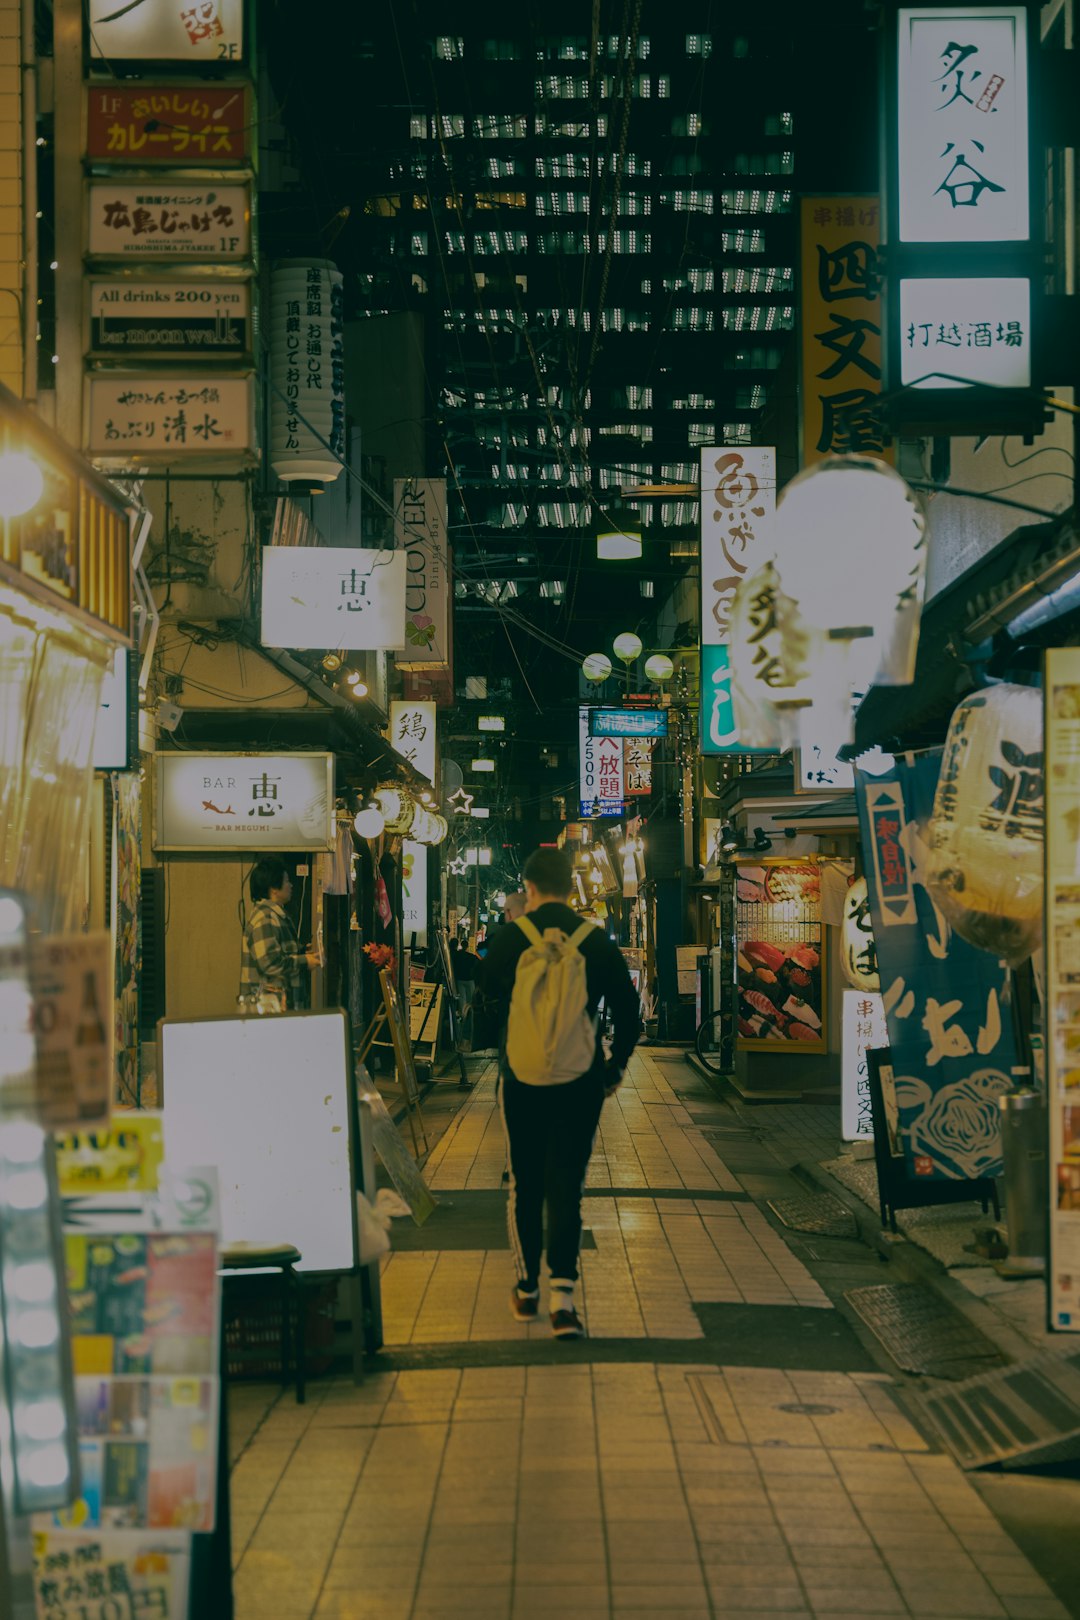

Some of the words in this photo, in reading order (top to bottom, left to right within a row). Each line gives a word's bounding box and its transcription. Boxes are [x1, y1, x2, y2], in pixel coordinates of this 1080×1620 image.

[217, 43, 238, 59] 2F
[99, 93, 122, 114] 1F
[132, 94, 209, 119] おいしい
[106, 122, 233, 153] カレーライス
[931, 41, 1007, 208] 炙谷
[123, 244, 178, 252] HIROSHIMA
[220, 237, 239, 252] 1F
[99, 290, 119, 303] All
[124, 290, 170, 303] drinks
[175, 291, 211, 303] 200
[215, 293, 240, 304] yen
[307, 267, 321, 317] 座席料
[99, 308, 125, 345] bar
[127, 328, 185, 345] moon
[186, 309, 241, 345] walk
[907, 319, 1025, 349] 打越酒場
[307, 324, 322, 390] お通し代
[813, 240, 883, 454] 四文屋
[430, 516, 439, 538] Bar
[403, 489, 426, 613] CLOVER
[430, 542, 439, 589] Dining
[337, 568, 371, 612] 恵
[203, 777, 237, 789] BAR
[248, 772, 283, 817] 恵
